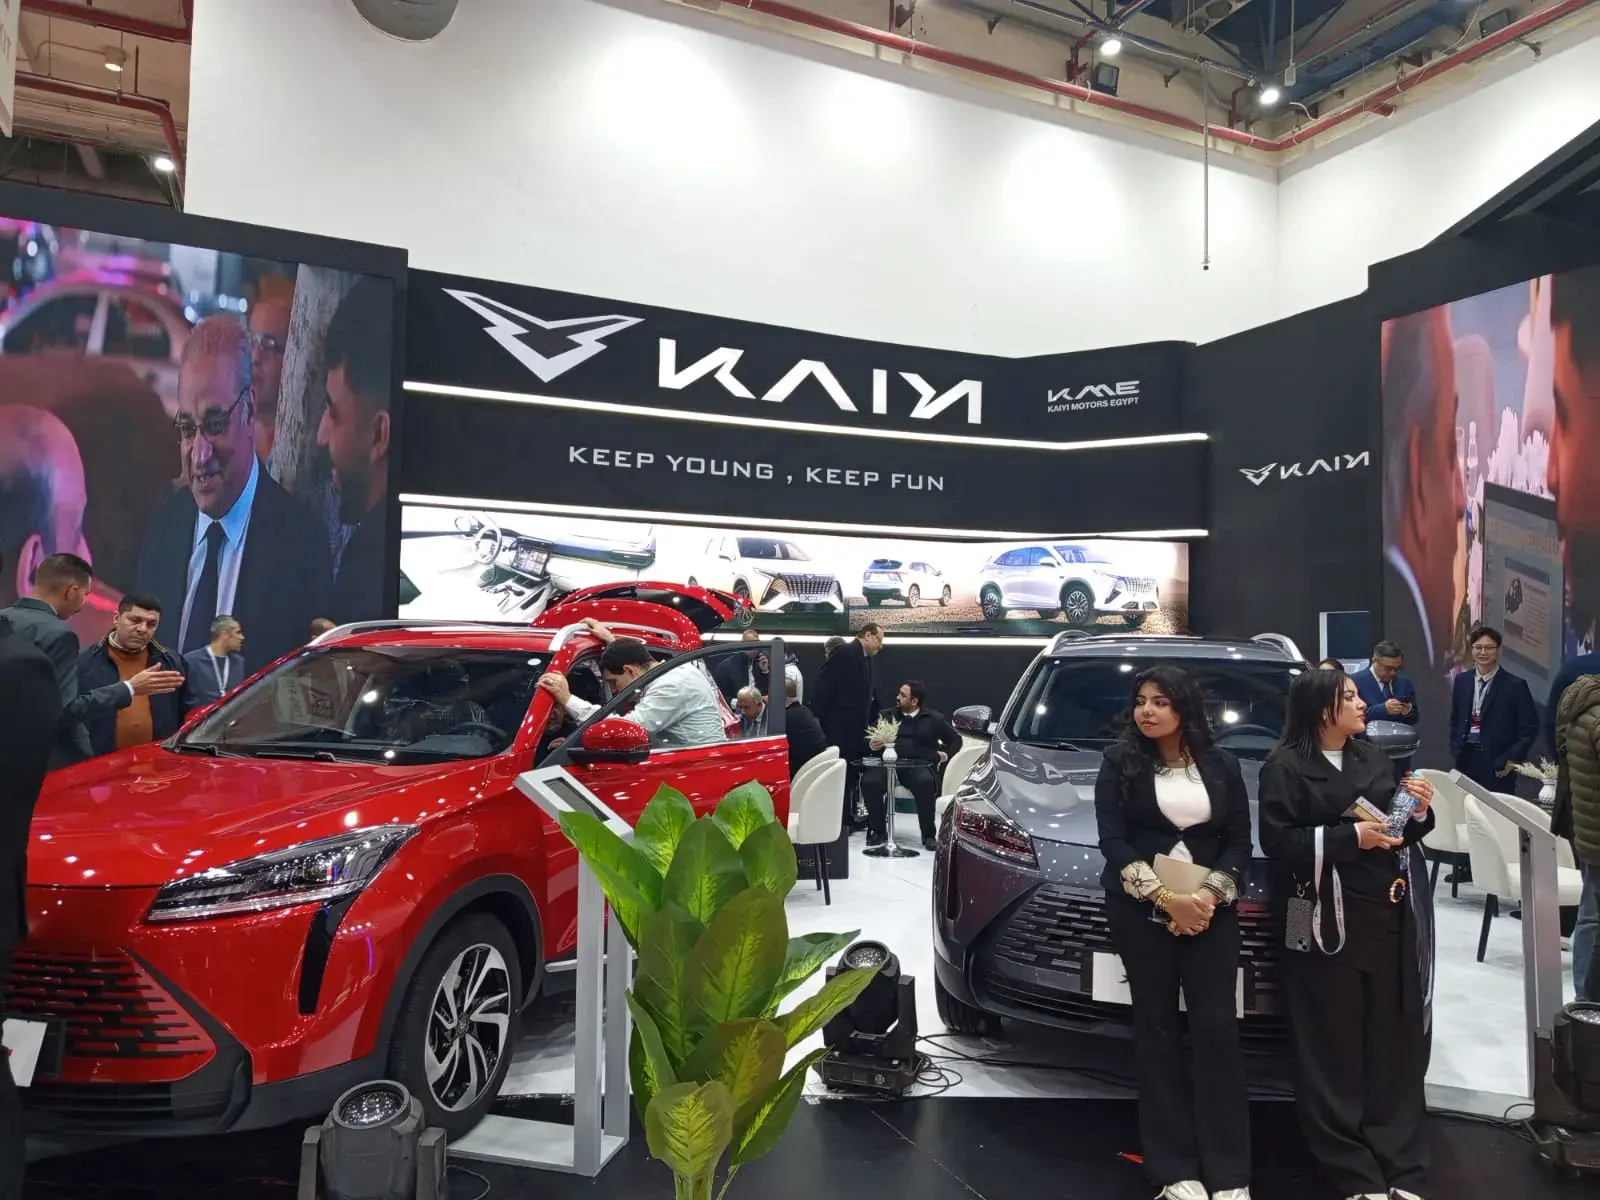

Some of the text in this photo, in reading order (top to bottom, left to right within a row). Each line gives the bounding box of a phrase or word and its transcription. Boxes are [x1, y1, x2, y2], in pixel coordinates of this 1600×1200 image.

[1047, 397, 1140, 413] KAIYI MOTORS EGYPT
[569, 446, 655, 469] KEEP
[666, 455, 774, 480] YOUNG
[806, 466, 880, 487] KEEP
[891, 471, 945, 491] FUN
